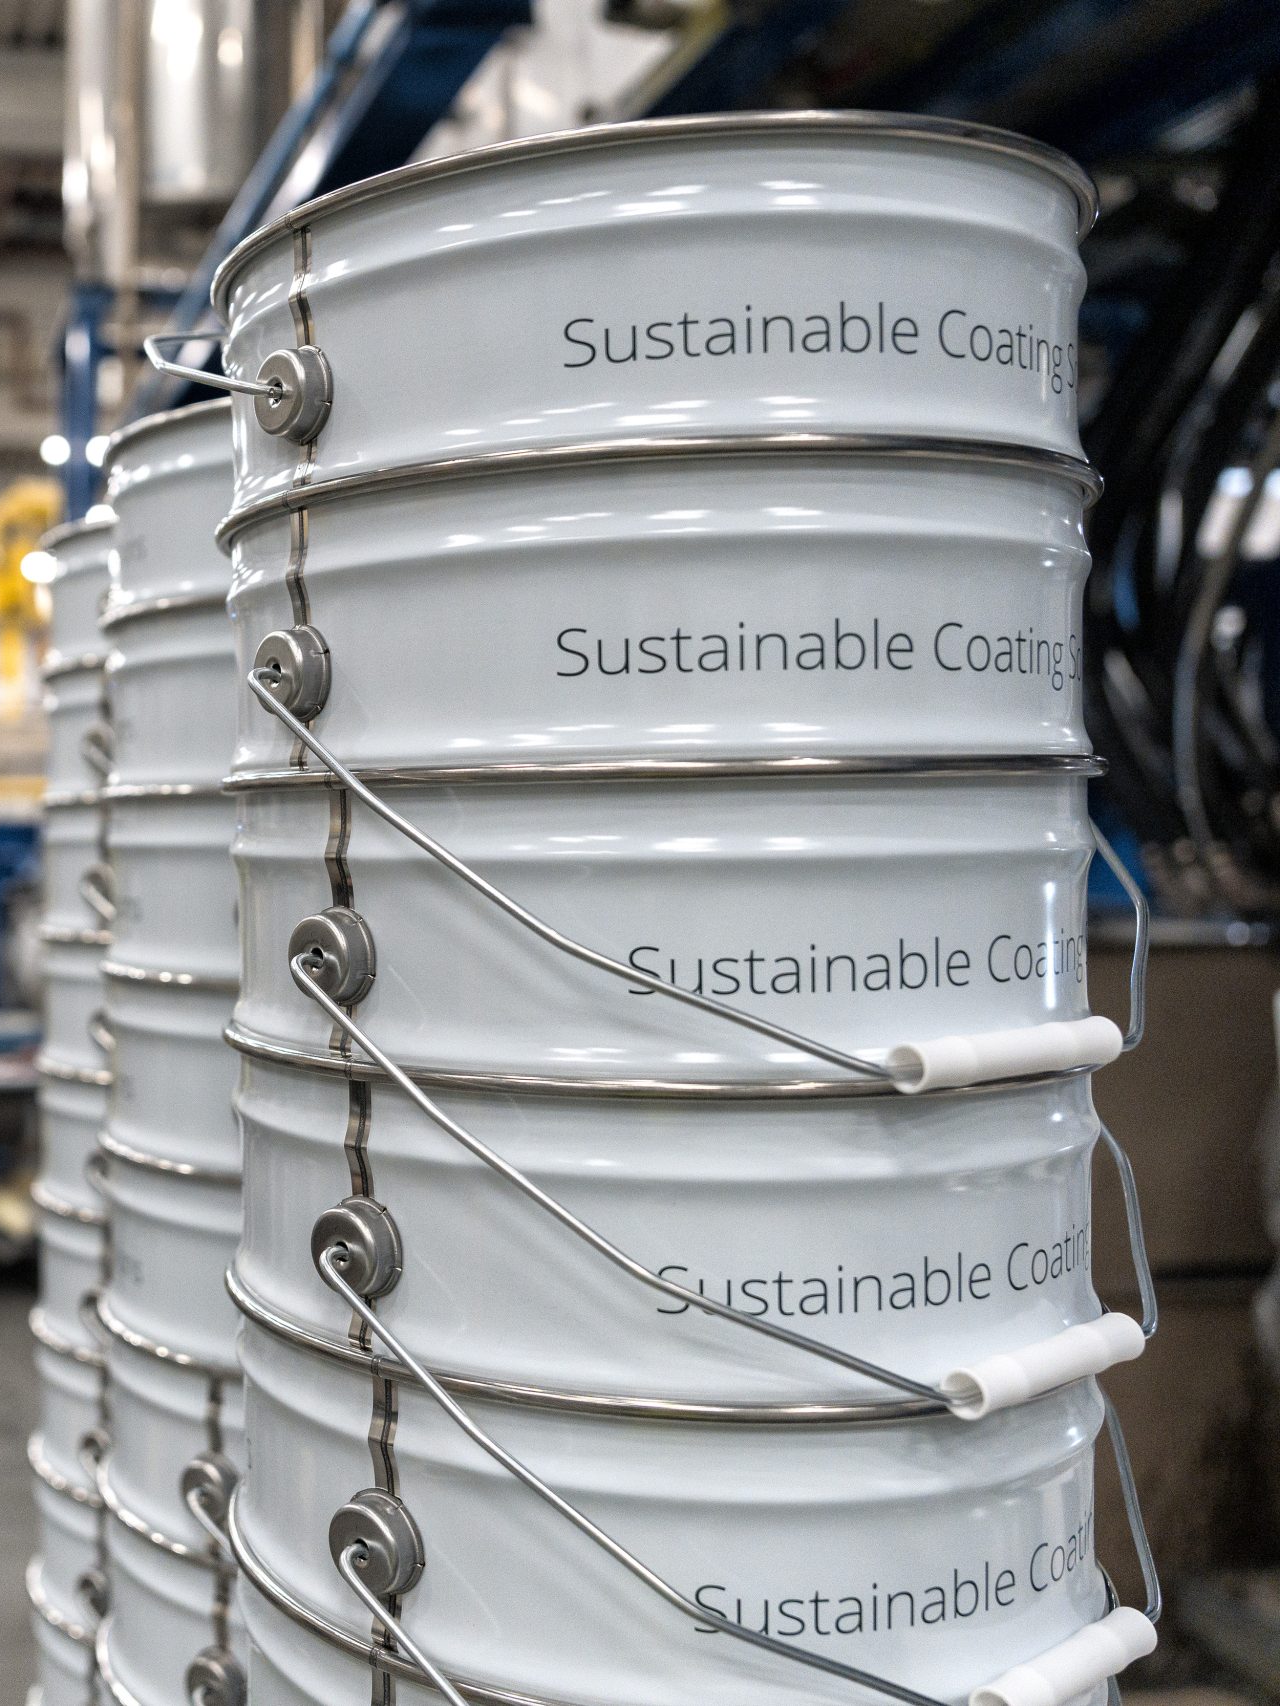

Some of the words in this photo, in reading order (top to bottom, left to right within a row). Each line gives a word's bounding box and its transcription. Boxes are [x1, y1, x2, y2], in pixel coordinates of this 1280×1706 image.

[563, 301, 919, 368] Sustainable
[938, 309, 1063, 394] Coating
[556, 617, 914, 677] Sustainable
[933, 622, 1063, 691] Coating
[628, 936, 971, 995] Sustainable
[656, 1252, 992, 1315] Sustainable
[694, 1561, 1016, 1636] Sustainable
